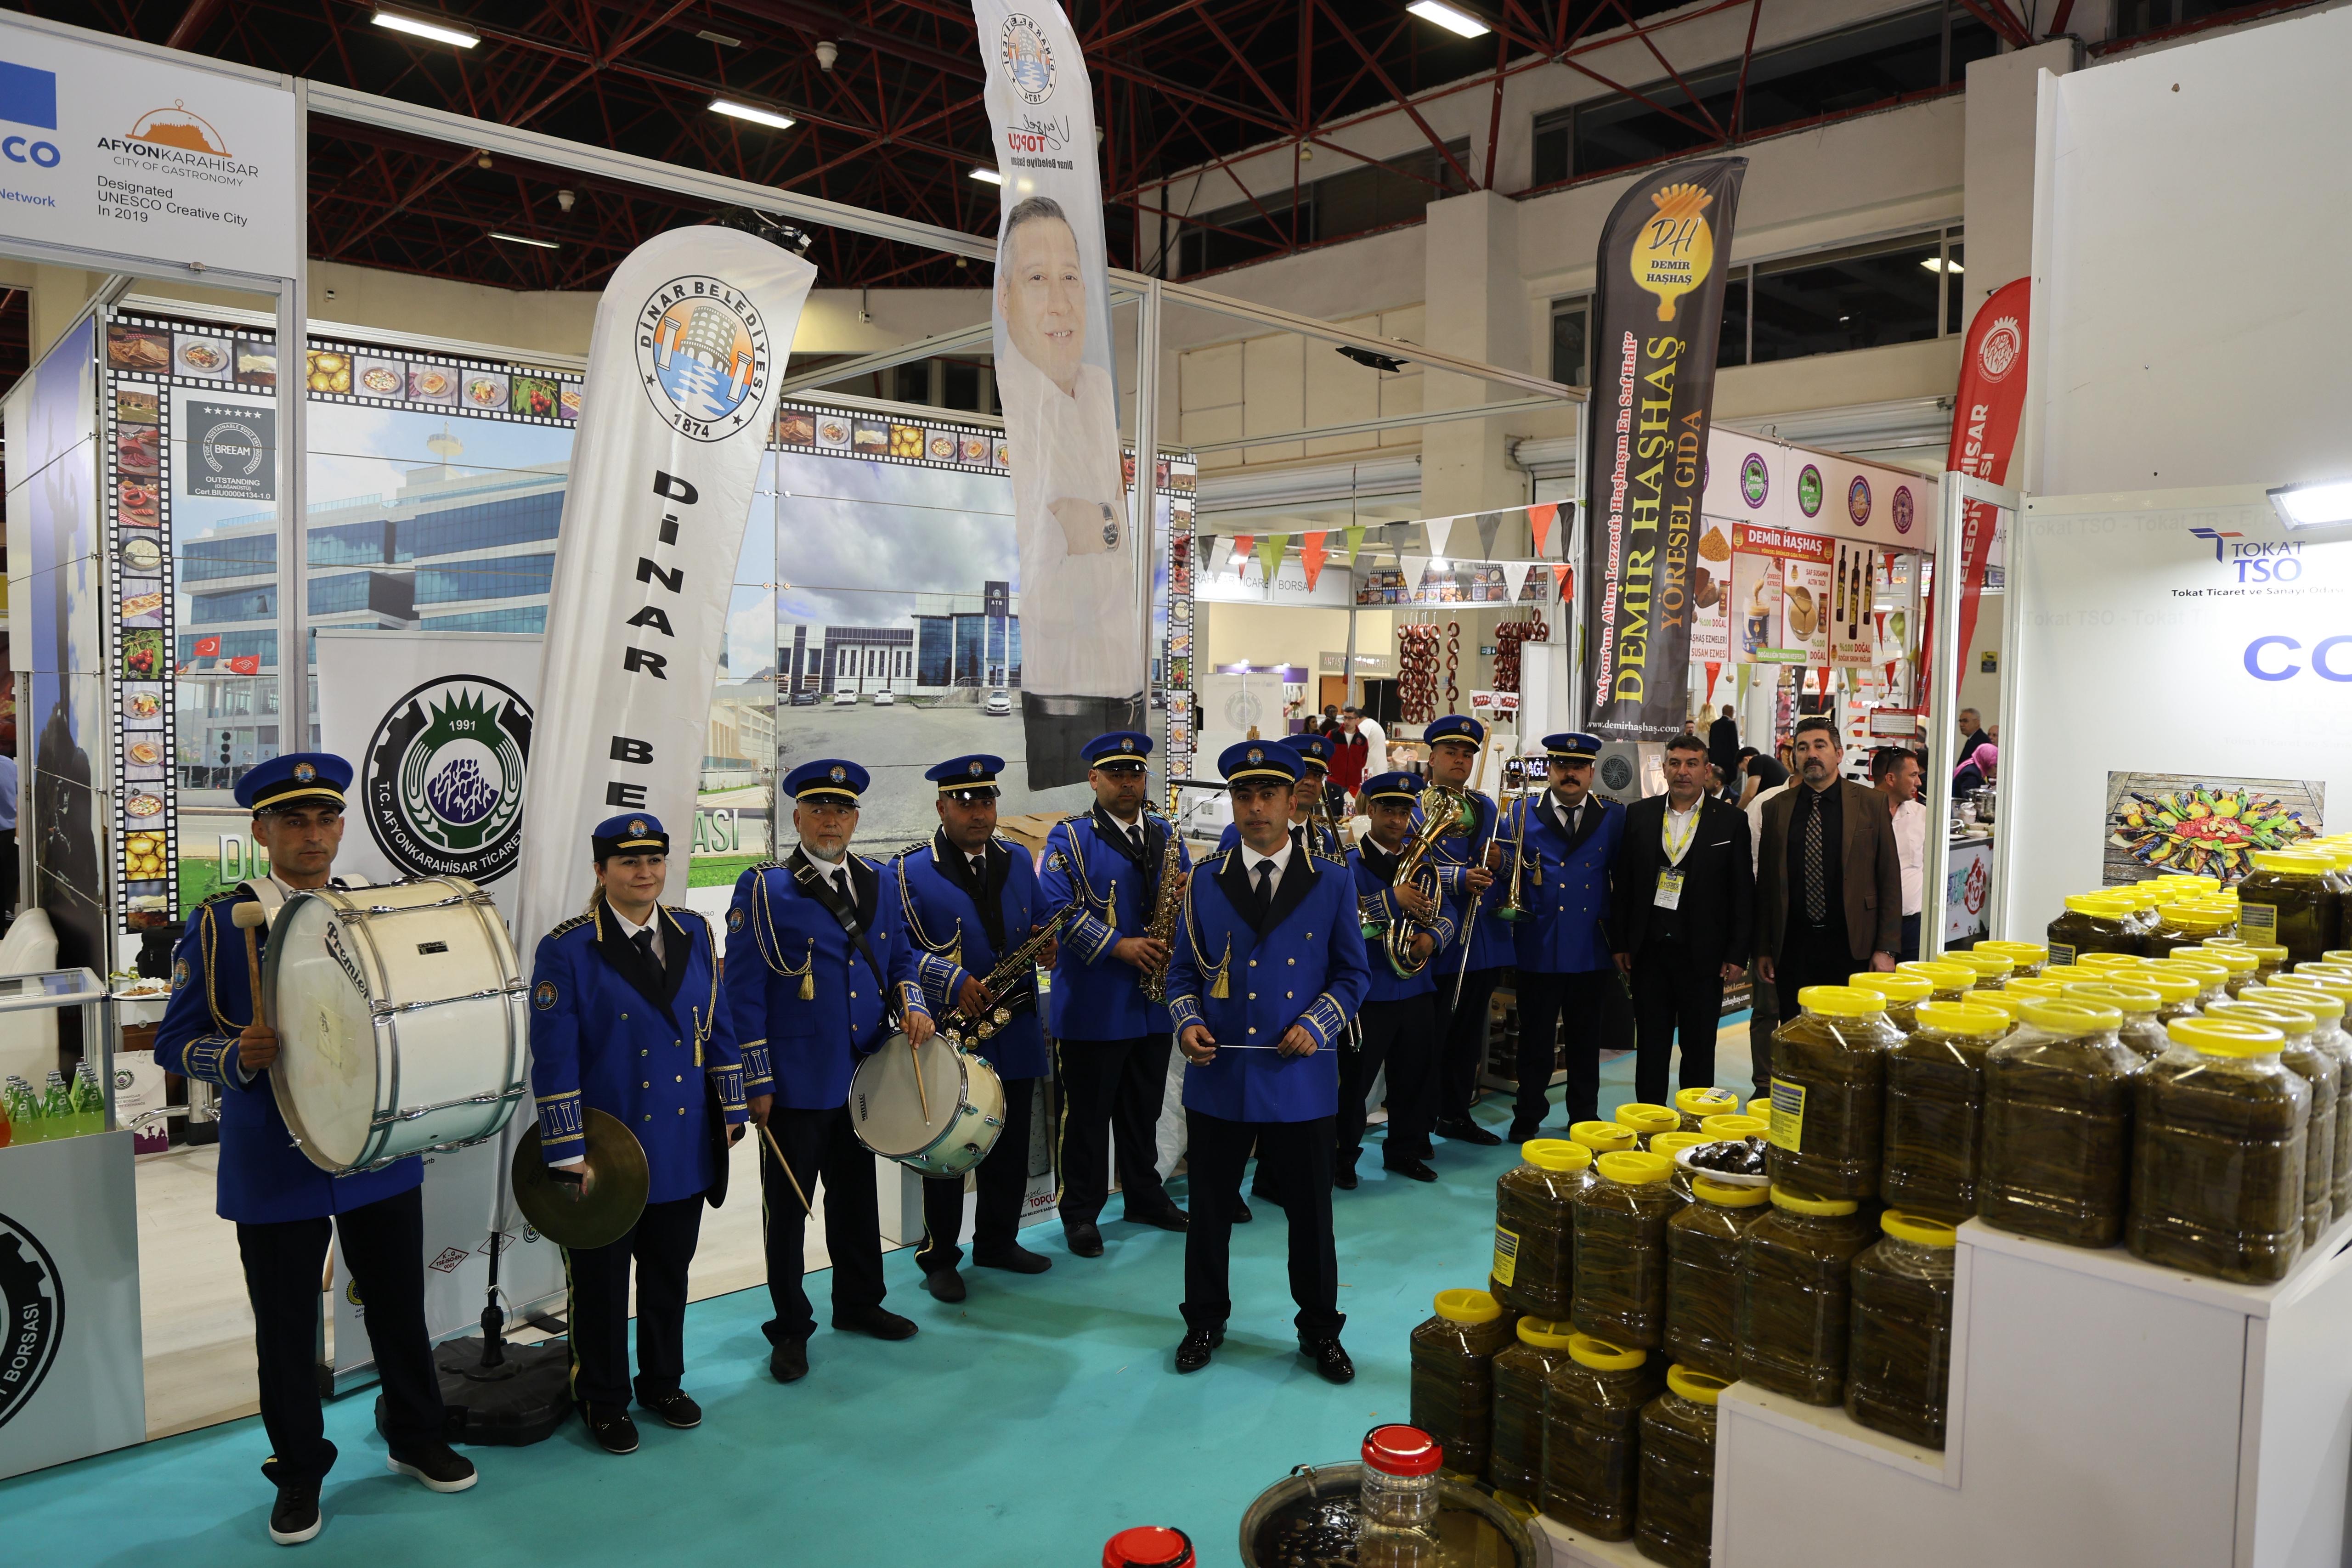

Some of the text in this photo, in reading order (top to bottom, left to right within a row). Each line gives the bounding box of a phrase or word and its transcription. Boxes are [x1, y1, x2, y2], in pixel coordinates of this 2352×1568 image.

[97, 137, 258, 178] AFYONKARAHİSAR
[113, 157, 243, 187] CITY OF GASTRONOMY
[97, 175, 173, 199] Designated
[98, 190, 248, 227] UNESCO Creative City
[98, 205, 148, 223] In 2019
[1651, 259, 1691, 270] DEMİR
[1646, 273, 1692, 285] HAŞHAŞ
[640, 281, 766, 403] DİNAR BELEDİYESİ
[1620, 377, 1634, 406] Saf
[240, 426, 254, 437] BUILT
[673, 413, 710, 438] 1874
[1617, 408, 1630, 433] En
[215, 444, 251, 456] BREEAM
[206, 476, 260, 486] OUTSTANDING
[1610, 434, 1629, 513] Haşhaşın
[1614, 336, 1686, 705] DEMİR HAŞHAŞ
[1657, 408, 1702, 631] YÖRESEL GIDA
[1748, 530, 1822, 555] DEMİR HAŞHAŞ
[2231, 541, 2306, 557] TOKAT
[623, 469, 699, 681] DİNAR
[2233, 558, 2302, 583] TSO
[1602, 582, 1617, 625] Altın
[2206, 588, 2245, 597] Ticaret
[2266, 587, 2305, 596] Sanayi
[1712, 618, 1726, 628] DOĞAL
[1706, 634, 1727, 644] EZMELERİ
[1839, 642, 1871, 653] %100 DOĞAL
[1691, 648, 1727, 658] SUSAM EZMESİ
[1810, 650, 1826, 660] DOĞAL
[449, 719, 476, 732] 1991
[379, 781, 390, 807] T.C.
[382, 809, 477, 874] AFYONKARAHİSAR
[327, 920, 369, 1000] Premier
[1029, 1193, 1056, 1208] TOPÇU
[5, 1303, 39, 1383] BORSASI
